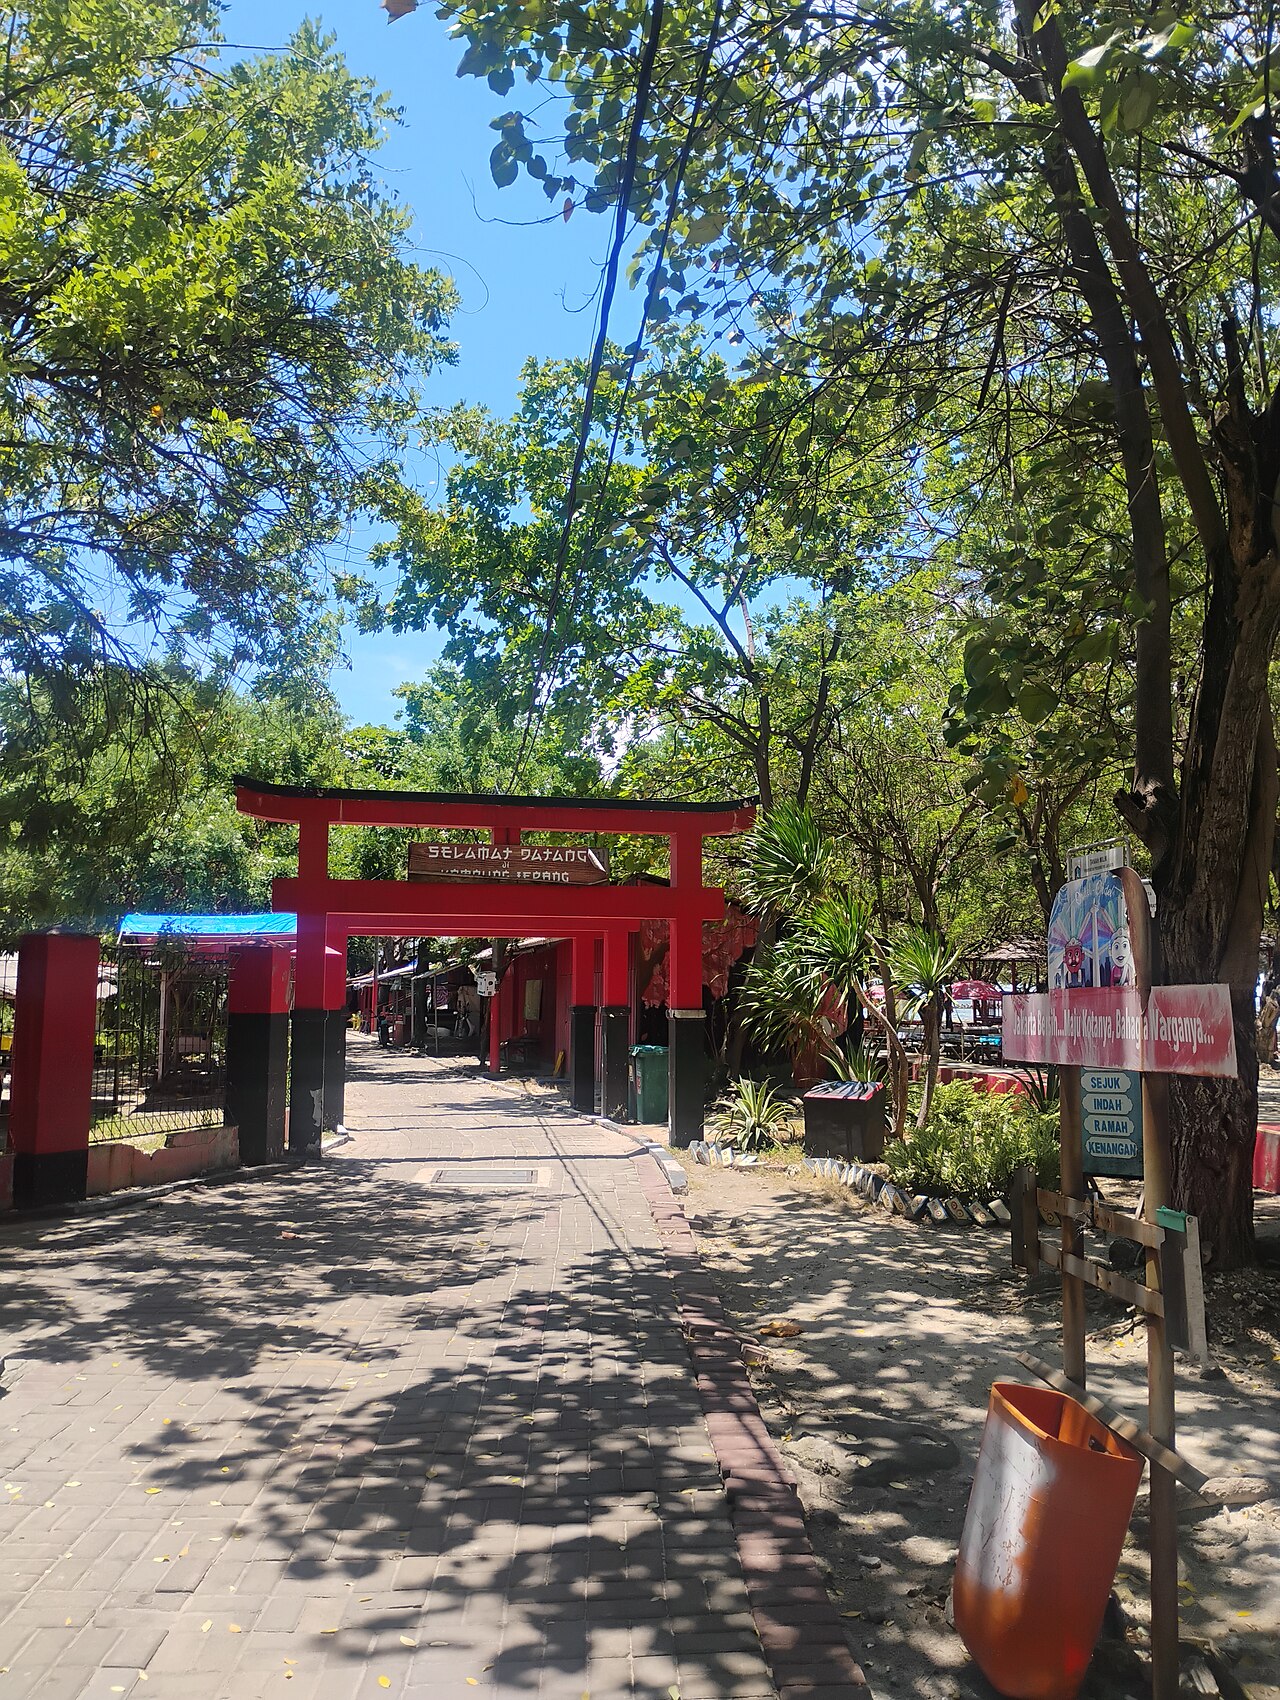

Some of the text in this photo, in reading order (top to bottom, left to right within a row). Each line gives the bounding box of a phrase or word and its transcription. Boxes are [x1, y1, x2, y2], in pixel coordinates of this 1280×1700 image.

[428, 846, 587, 863] SELAMAT DATANG
[1116, 1007, 1149, 1050] Bahaga
[1090, 1077, 1120, 1089] SEJUK
[1093, 1098, 1122, 1111] INDAH
[1094, 1120, 1128, 1133] RAMAH
[1088, 1141, 1137, 1156] KENANGAN
